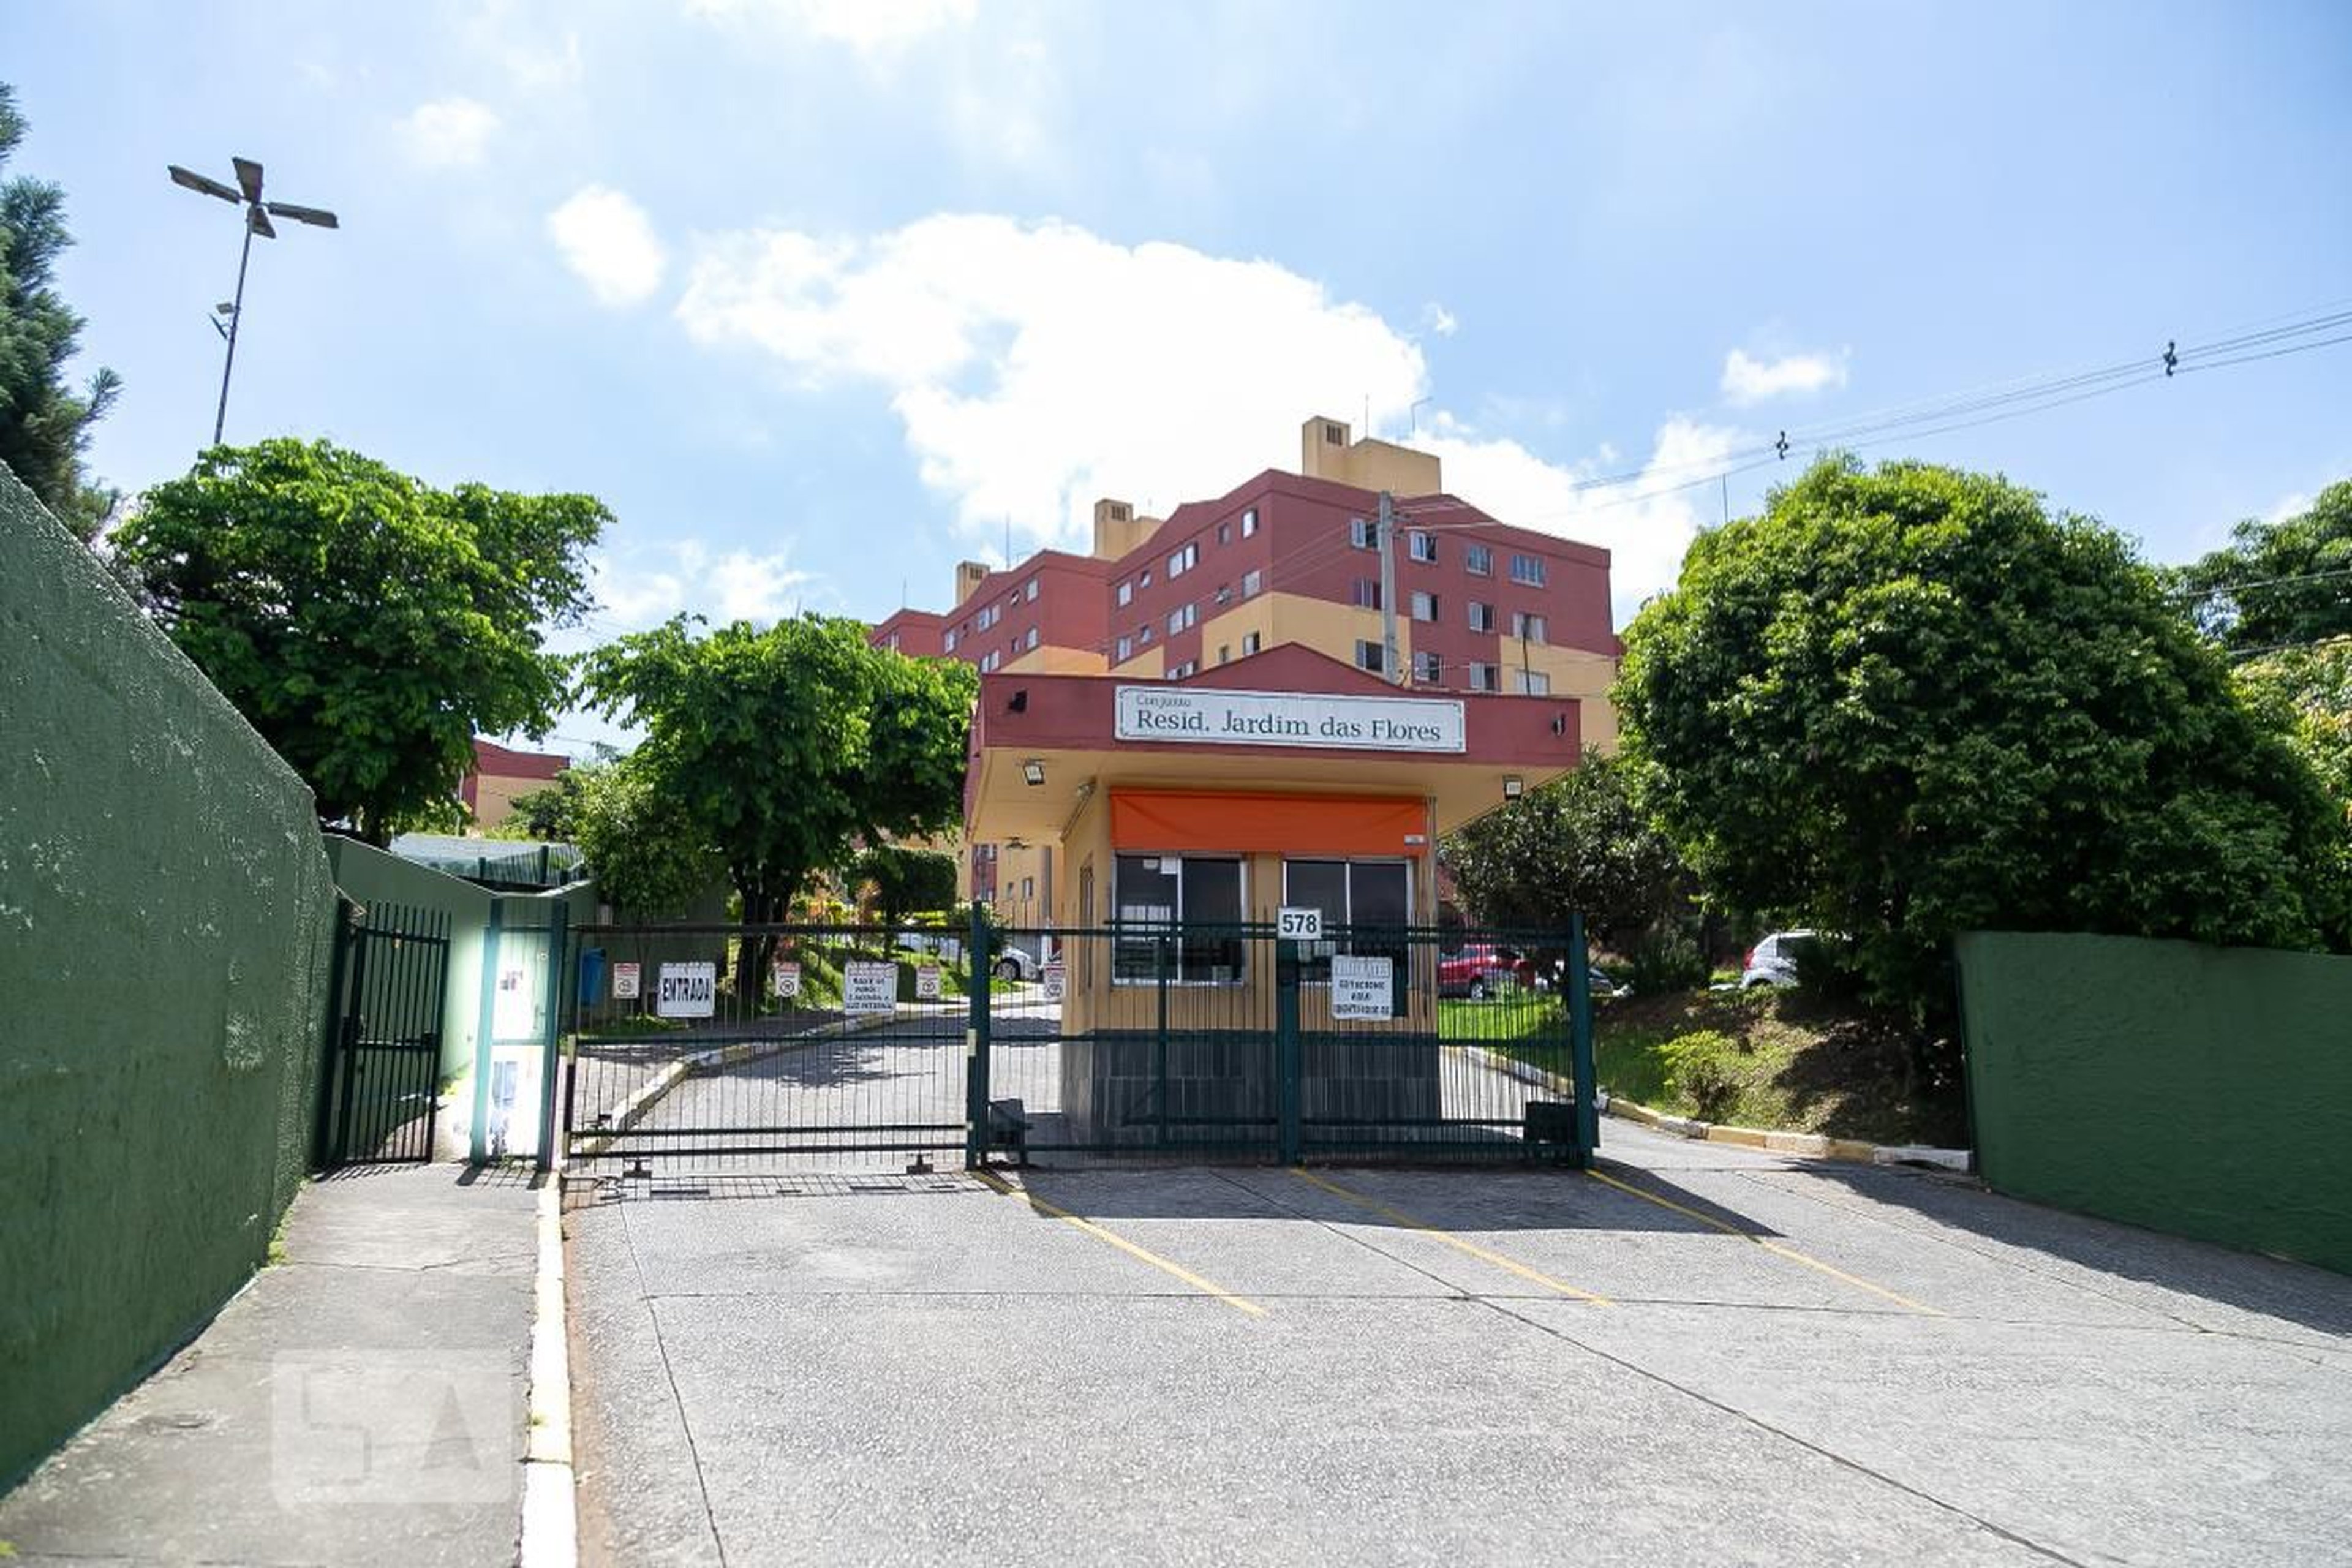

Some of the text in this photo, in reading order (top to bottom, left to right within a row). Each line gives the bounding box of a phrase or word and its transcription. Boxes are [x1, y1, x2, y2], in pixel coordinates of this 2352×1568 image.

[1136, 695, 1191, 709] Conjunto
[1138, 709, 1441, 741] Resid. Jardim das Flores
[1282, 914, 1317, 933] 578
[663, 978, 710, 1002] ENTRADA
